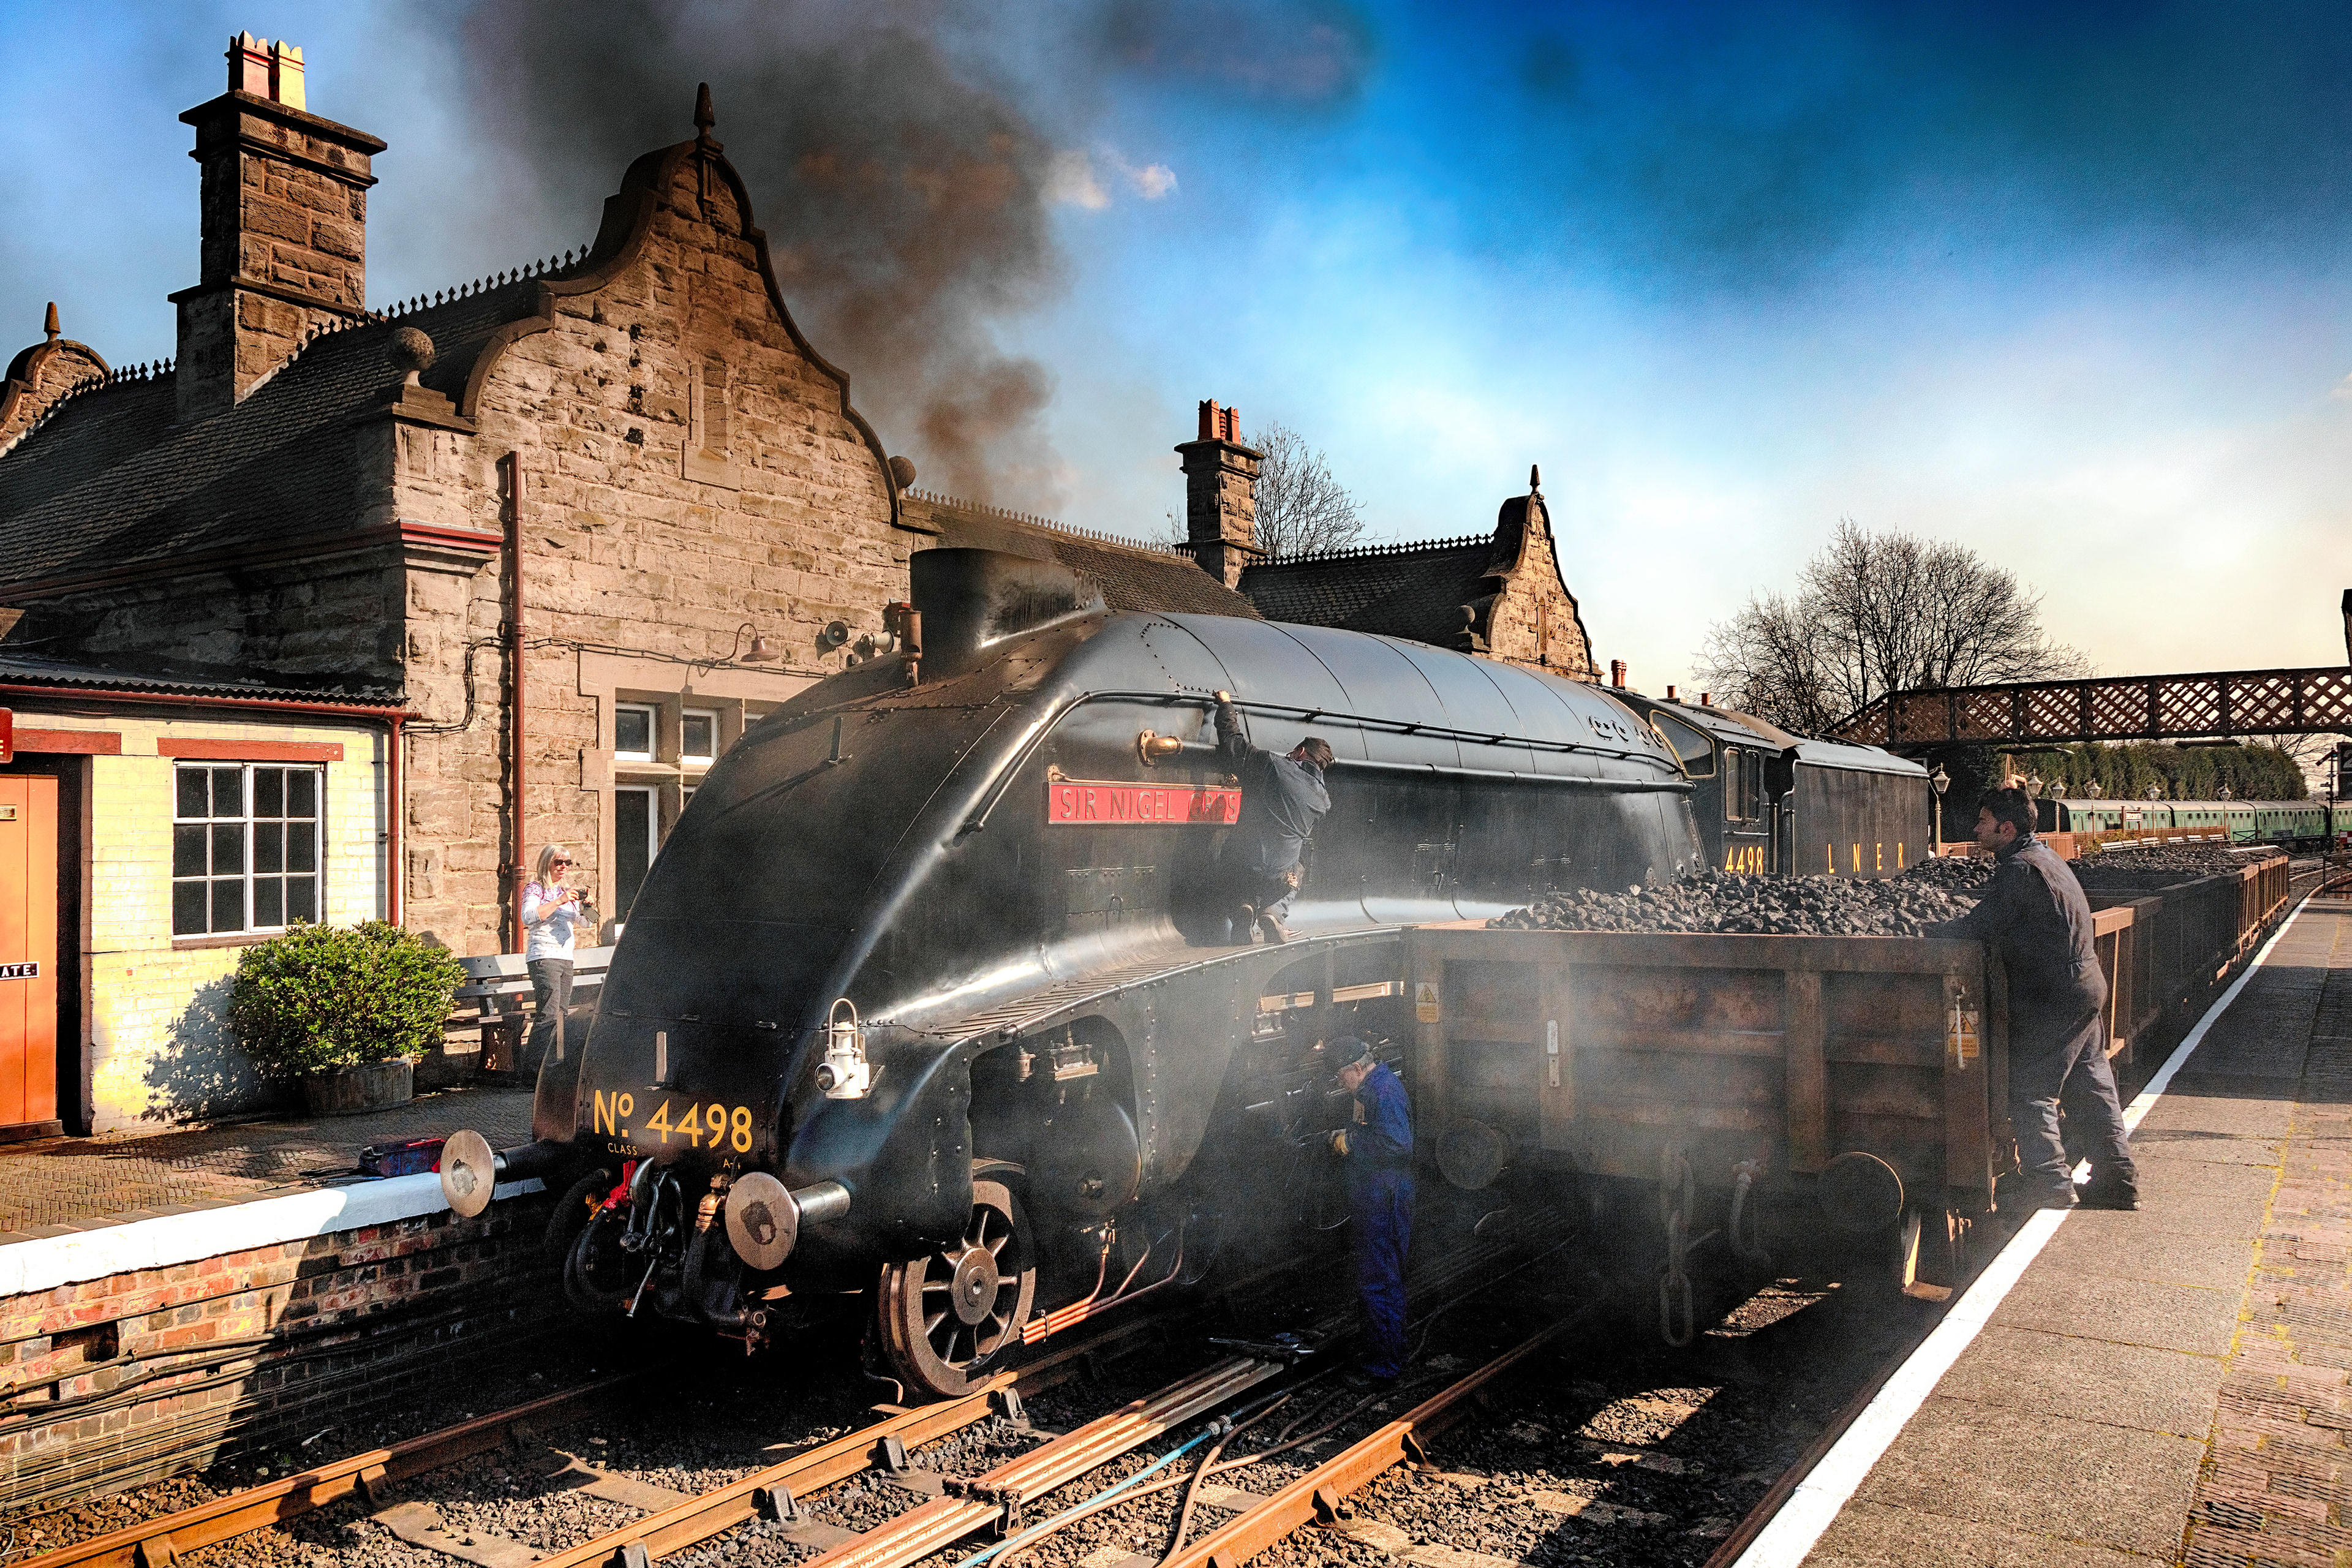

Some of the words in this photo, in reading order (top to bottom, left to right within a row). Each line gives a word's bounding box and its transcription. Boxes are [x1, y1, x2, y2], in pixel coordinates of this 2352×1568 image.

[1061, 789, 1098, 818] SIR
[1110, 790, 1175, 819] NIGEL
[1725, 846, 1763, 875] 4498
[1, 965, 31, 977] ATE
[645, 1098, 752, 1153] 4498
[608, 1142, 637, 1156] CLASS
